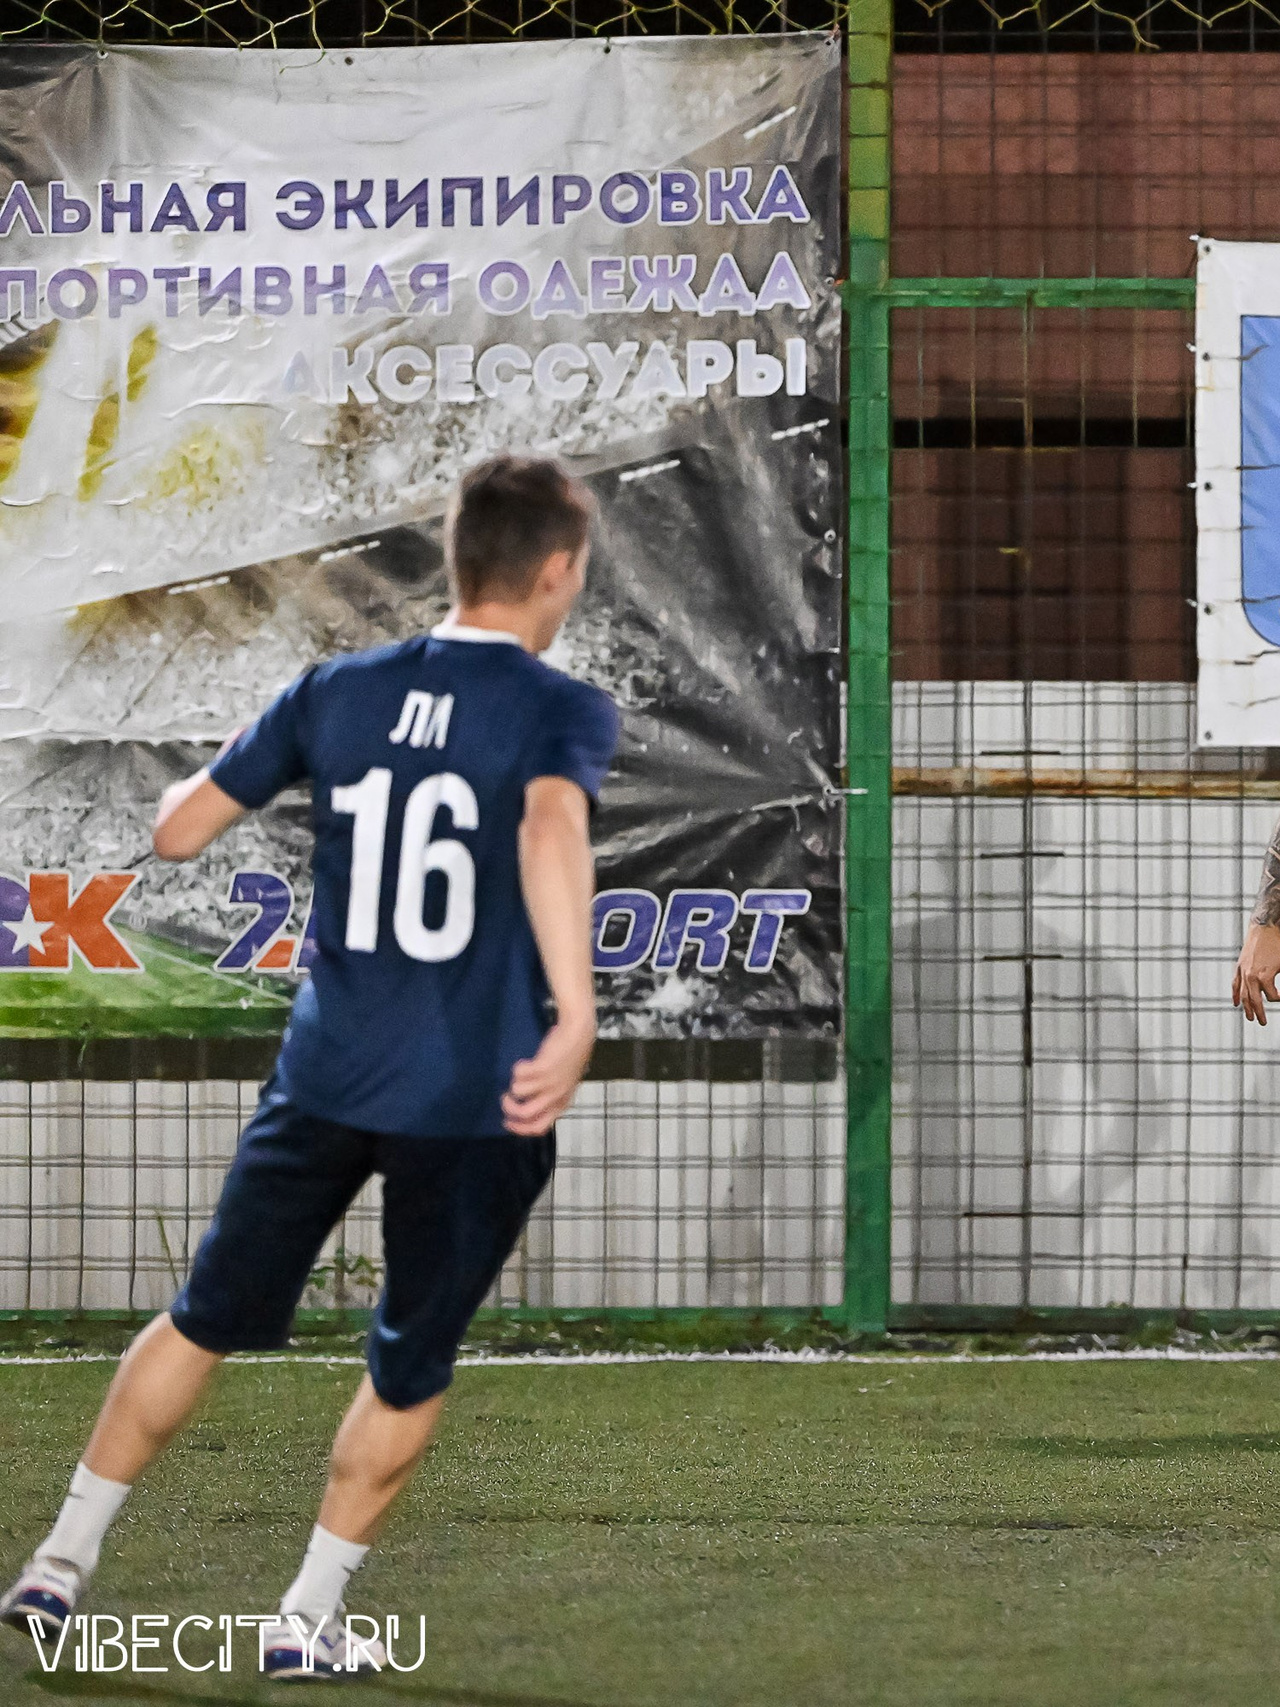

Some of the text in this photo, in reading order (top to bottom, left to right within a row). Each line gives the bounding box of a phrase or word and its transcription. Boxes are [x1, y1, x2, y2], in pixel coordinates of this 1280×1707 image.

[0, 166, 808, 235] ЛЬНАЯ ЭКИПИРОВКА
[0, 252, 811, 320] ПОРТИВНАЯ ОДЕЖДА
[286, 337, 806, 404] АКСЕССУАРЫ
[388, 688, 455, 750] ЛИ
[330, 766, 480, 963] 16
